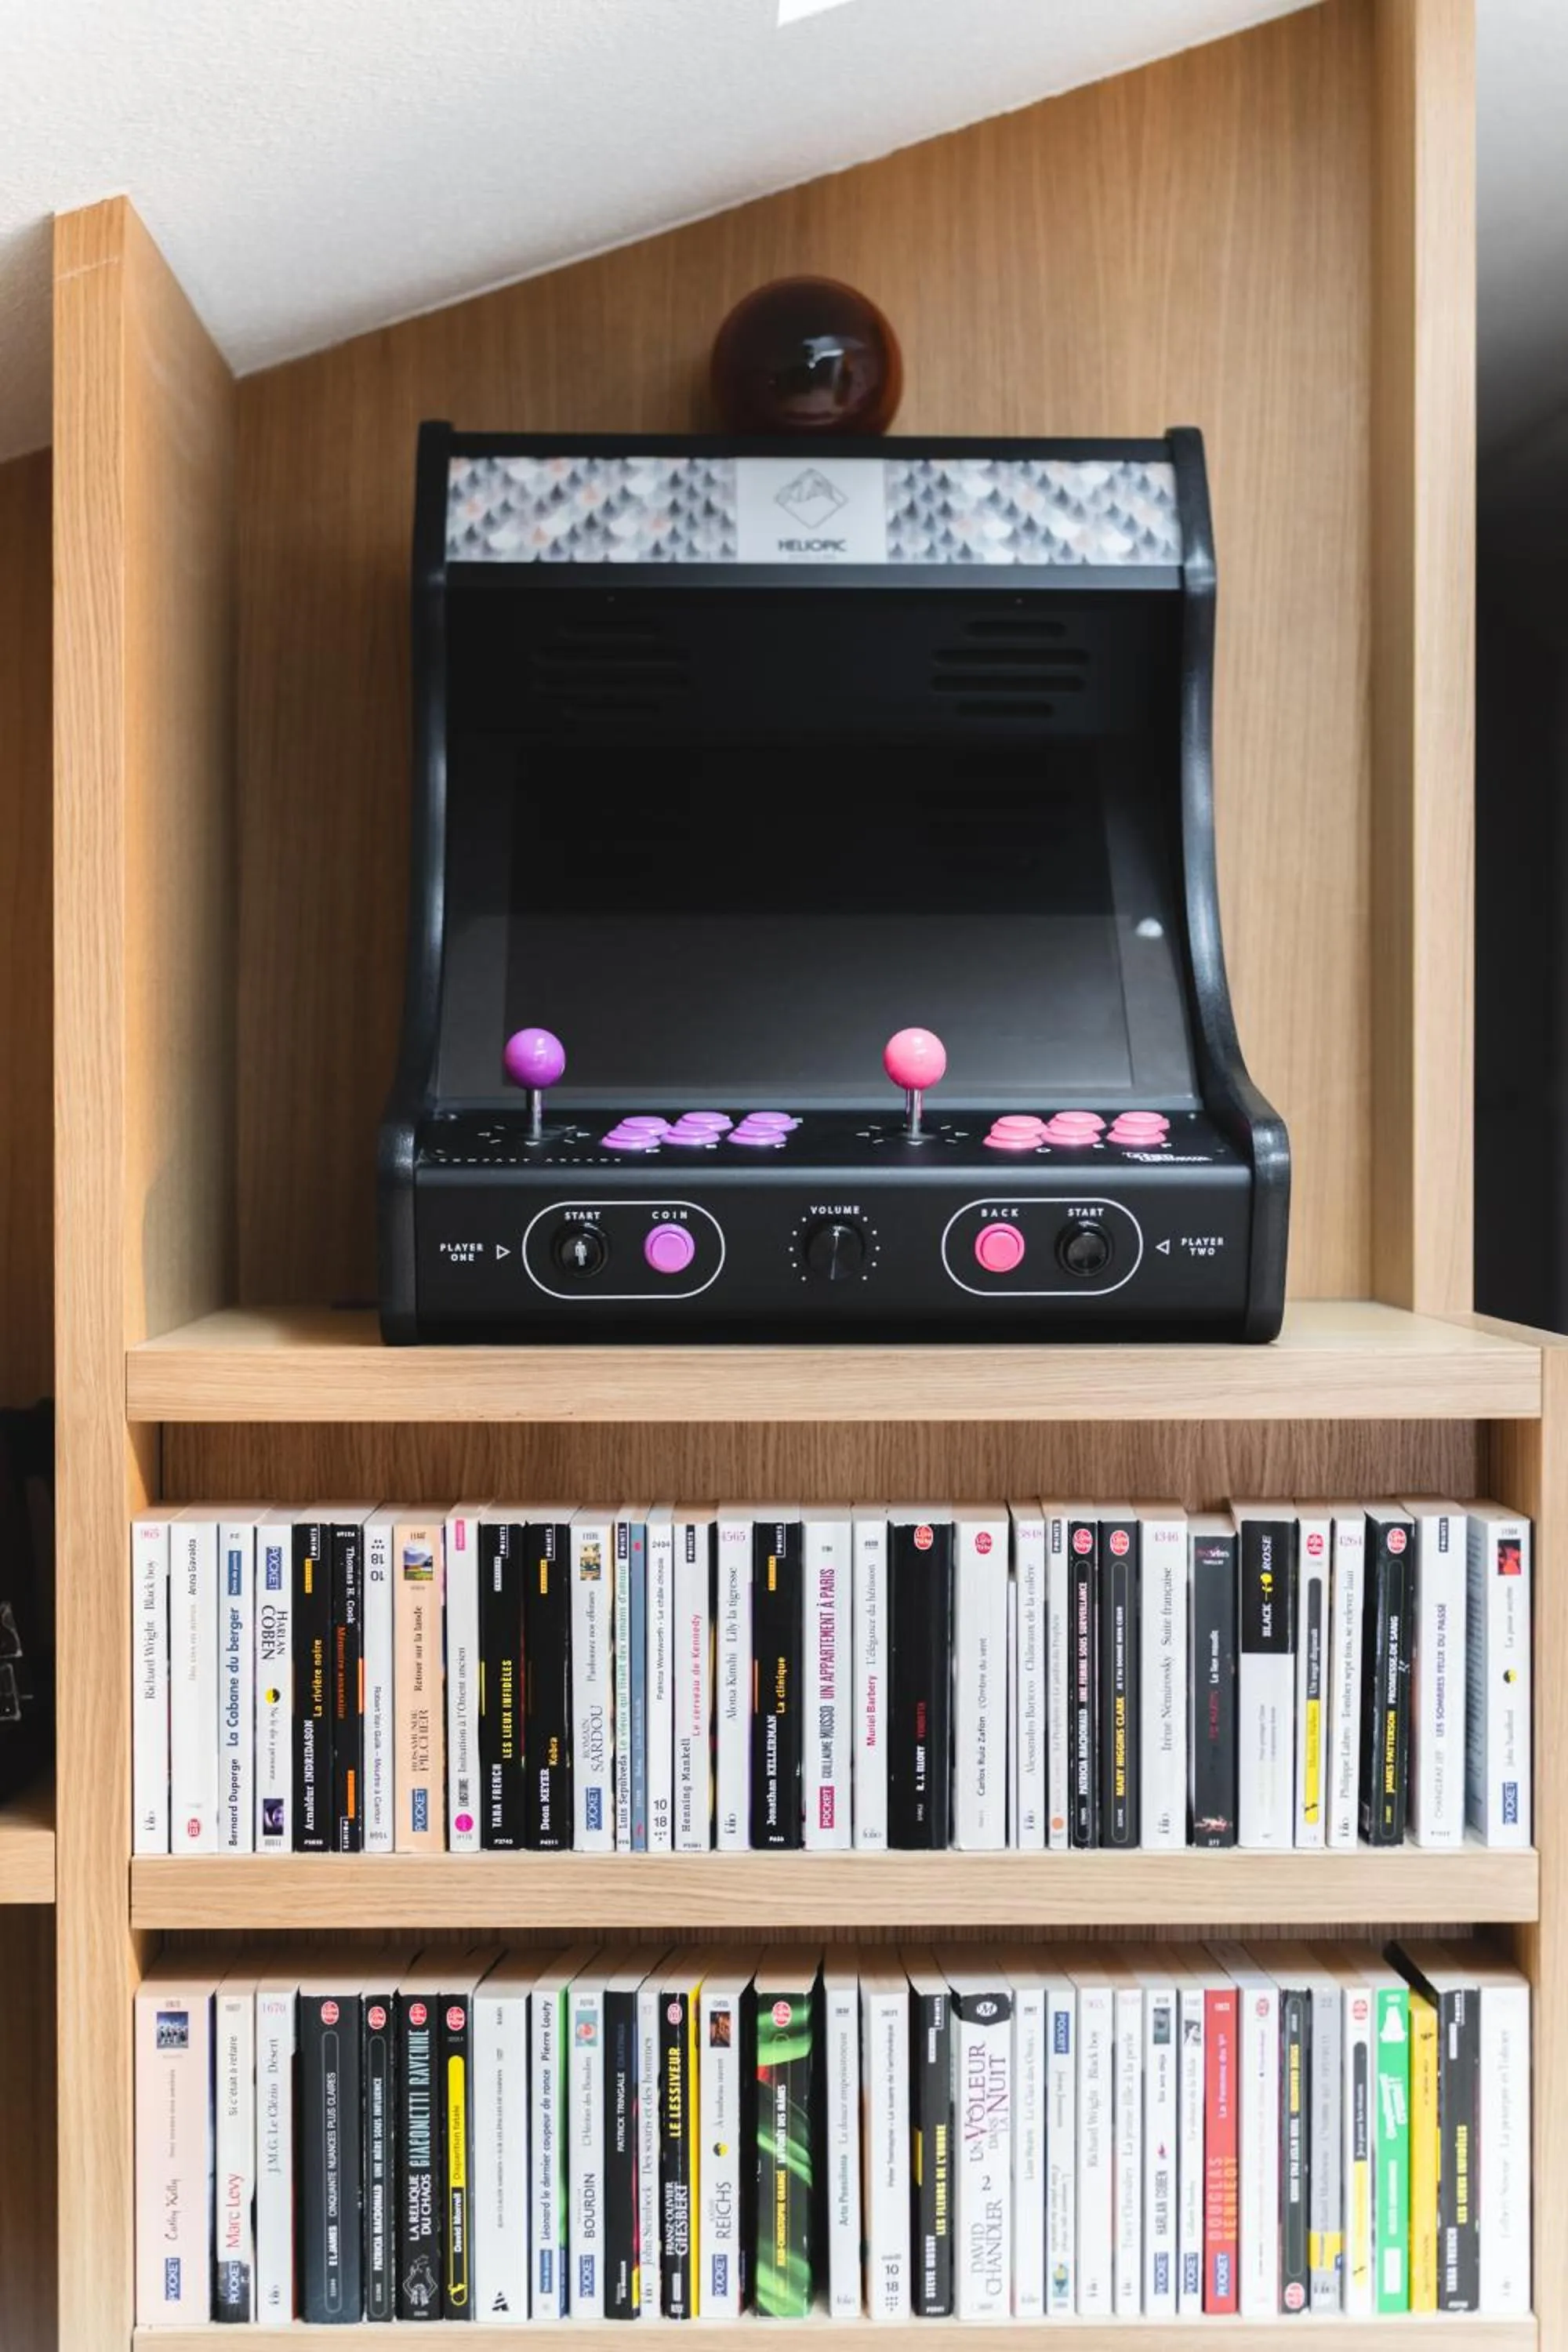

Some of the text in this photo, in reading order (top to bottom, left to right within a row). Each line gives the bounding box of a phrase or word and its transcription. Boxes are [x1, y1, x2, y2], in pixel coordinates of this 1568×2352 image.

[564, 1211, 601, 1221] START
[652, 1211, 688, 1220] COIN
[811, 1206, 860, 1215] VOLUME
[982, 1209, 1018, 1218] BACK
[1068, 1208, 1104, 1218] START
[440, 1243, 484, 1253] PLAYER
[451, 1254, 474, 1262] ONE
[1181, 1238, 1224, 1247] PLAYER
[1190, 1247, 1215, 1256] TWO
[187, 1538, 198, 1572] Gavalda
[187, 1573, 198, 1595] Anna
[346, 1546, 356, 1624] Thomas H. Cook
[727, 1567, 739, 1606] tigresse
[819, 1569, 835, 1599] PARIS
[1161, 1567, 1174, 1616] française
[1262, 1535, 1272, 1637] BLACK ROSE
[143, 1559, 158, 1699] Richard Wright Black boy
[227, 1607, 243, 1651] berger
[618, 1606, 627, 1641] romans
[725, 1610, 737, 1619] la
[866, 1604, 876, 1616] du
[1389, 1616, 1399, 1640] SANG
[261, 1605, 275, 1660] COBEN
[276, 1611, 288, 1656] HARLAN
[413, 1606, 423, 1691] Retour sur la lande
[725, 1623, 739, 1642] Lily
[819, 1610, 835, 1682] APPARTEMENT
[1161, 1619, 1172, 1646] Suite
[1437, 1633, 1446, 1647] DU
[227, 1656, 239, 1672] du
[618, 1644, 627, 1661] des
[1436, 1650, 1446, 1674] FEUX
[311, 1639, 322, 1717] La rivière noire
[618, 1663, 627, 1690] lisait
[691, 1614, 702, 1737] Le cerveau de Kennedy
[775, 1657, 787, 1713] La clinique
[820, 1685, 834, 1699] UN
[866, 1675, 877, 1713] Barbery
[1210, 1674, 1219, 1683] Le
[227, 1677, 239, 1727] Cabane
[500, 1660, 513, 1758] LES LIEUX INFIDÈLES
[619, 1693, 630, 1708] qui
[1436, 1676, 1445, 1720] SOMBRES
[227, 1732, 239, 1747] La
[418, 1709, 429, 1772] PILCHER
[590, 1705, 604, 1772] SARDOU
[619, 1711, 627, 1737] vieux
[819, 1706, 834, 1738] MUSSO
[866, 1715, 877, 1746] Muriel
[1386, 1711, 1396, 1762] PATTERSON
[1436, 1722, 1445, 1737] LES
[549, 1737, 558, 1766] Kobra
[619, 1740, 627, 1751] Le
[822, 1740, 833, 1778] GUILLAUME
[1116, 1697, 1125, 1796] MARY HIGGINS CLARK
[304, 1719, 315, 1831] Arnaldur INDRIDASON
[618, 1755, 630, 1804] Sepúlveda
[681, 1738, 692, 1832] Henning Mankell
[767, 1715, 778, 1825] Jonathan KELLERMAN
[1385, 1765, 1396, 1793] JAMES
[492, 1763, 503, 1828] TANA FRENCH
[540, 1769, 550, 1831] Deon MEYER
[229, 1805, 239, 1846] Bernard
[618, 1806, 627, 1829] Luis
[542, 2031, 551, 2061] Pierre
[326, 2072, 336, 2106] CLAIRES
[540, 2099, 550, 2110] de
[670, 2047, 681, 2137] LE LESSIVEUR
[965, 2042, 988, 2141] VOLEUR
[989, 2055, 1008, 2116] NUIT
[327, 2108, 336, 2128] PLUS
[542, 2112, 553, 2151] coupeur
[617, 2116, 626, 2152] PATRICK
[327, 2131, 336, 2169] NUANCES
[541, 2154, 550, 2188] dernier
[226, 2174, 244, 2248] Marc Levy
[328, 2172, 337, 2216] CINQUANTE
[408, 2175, 420, 2241] LA RELIQUE
[420, 2174, 430, 2235] DU CHAOS
[584, 2173, 595, 2238] BOURDIN
[715, 2182, 731, 2238] REICHS
[1209, 2156, 1223, 2241] DOUGLAS
[1224, 2156, 1237, 2241] KENNEDY
[540, 2201, 551, 2240] Léonard
[666, 2182, 674, 2256] FRANZ-OLIVIER
[676, 2184, 688, 2256] GIESBERT
[936, 2219, 946, 2235] LES
[328, 2225, 338, 2252] JAMES
[970, 2223, 984, 2273] DAVID
[985, 2200, 1004, 2295] CHANDLER
